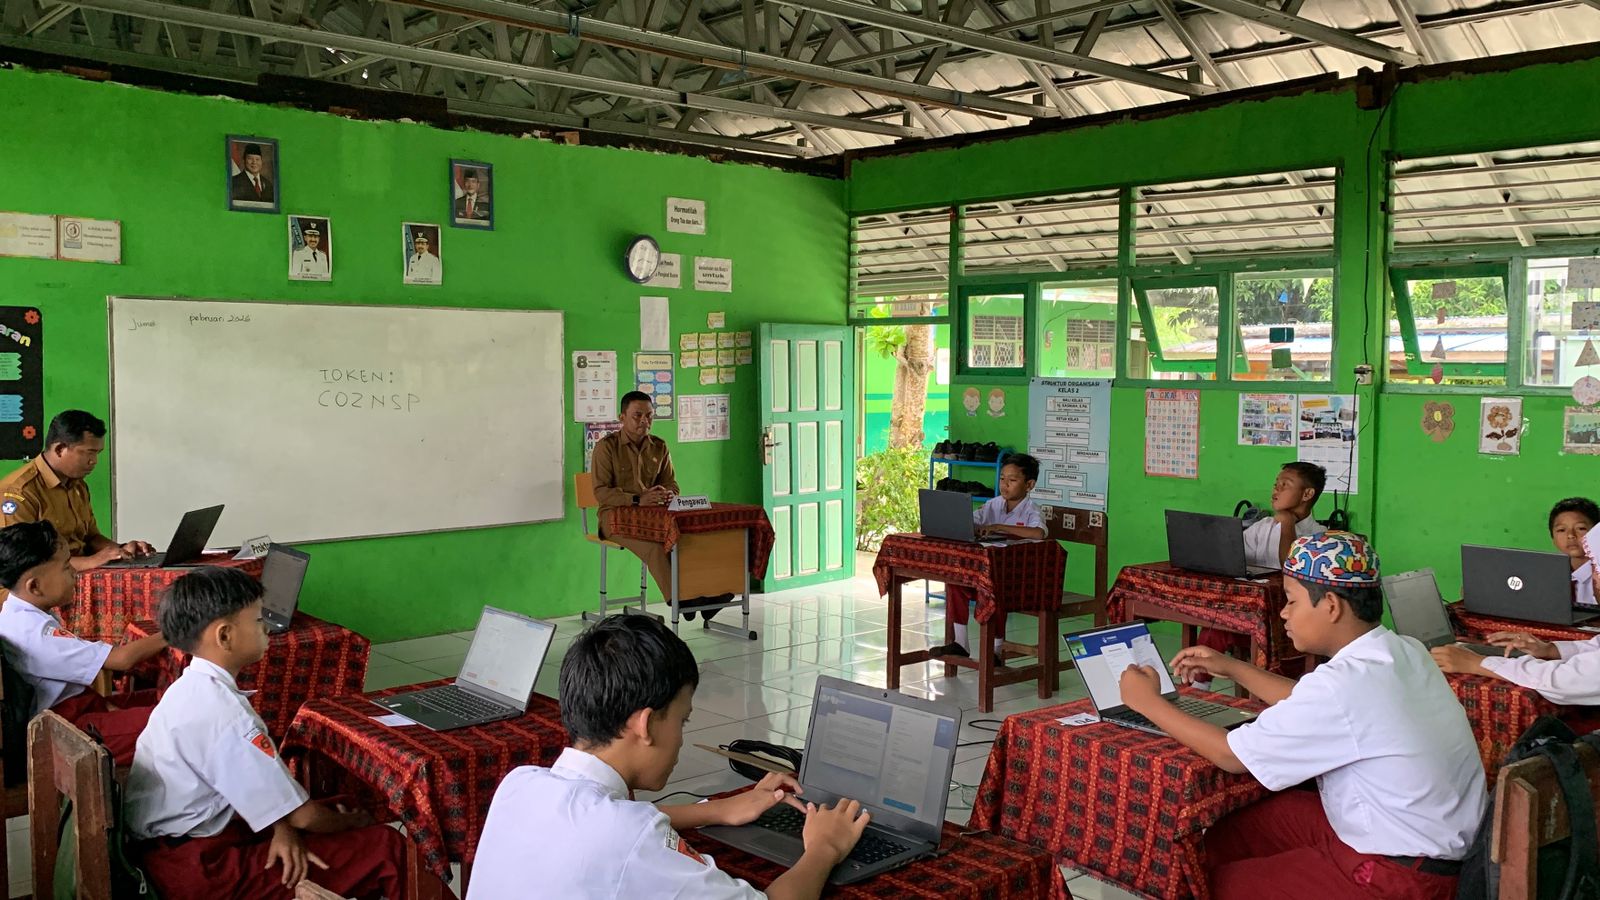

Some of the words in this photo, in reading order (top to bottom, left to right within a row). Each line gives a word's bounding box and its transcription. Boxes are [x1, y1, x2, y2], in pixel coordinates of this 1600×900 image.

[577, 355, 588, 369] 8
[319, 368, 393, 384] TOKEN:
[677, 498, 707, 507] Pengawas
[1510, 577, 1521, 589] hp
